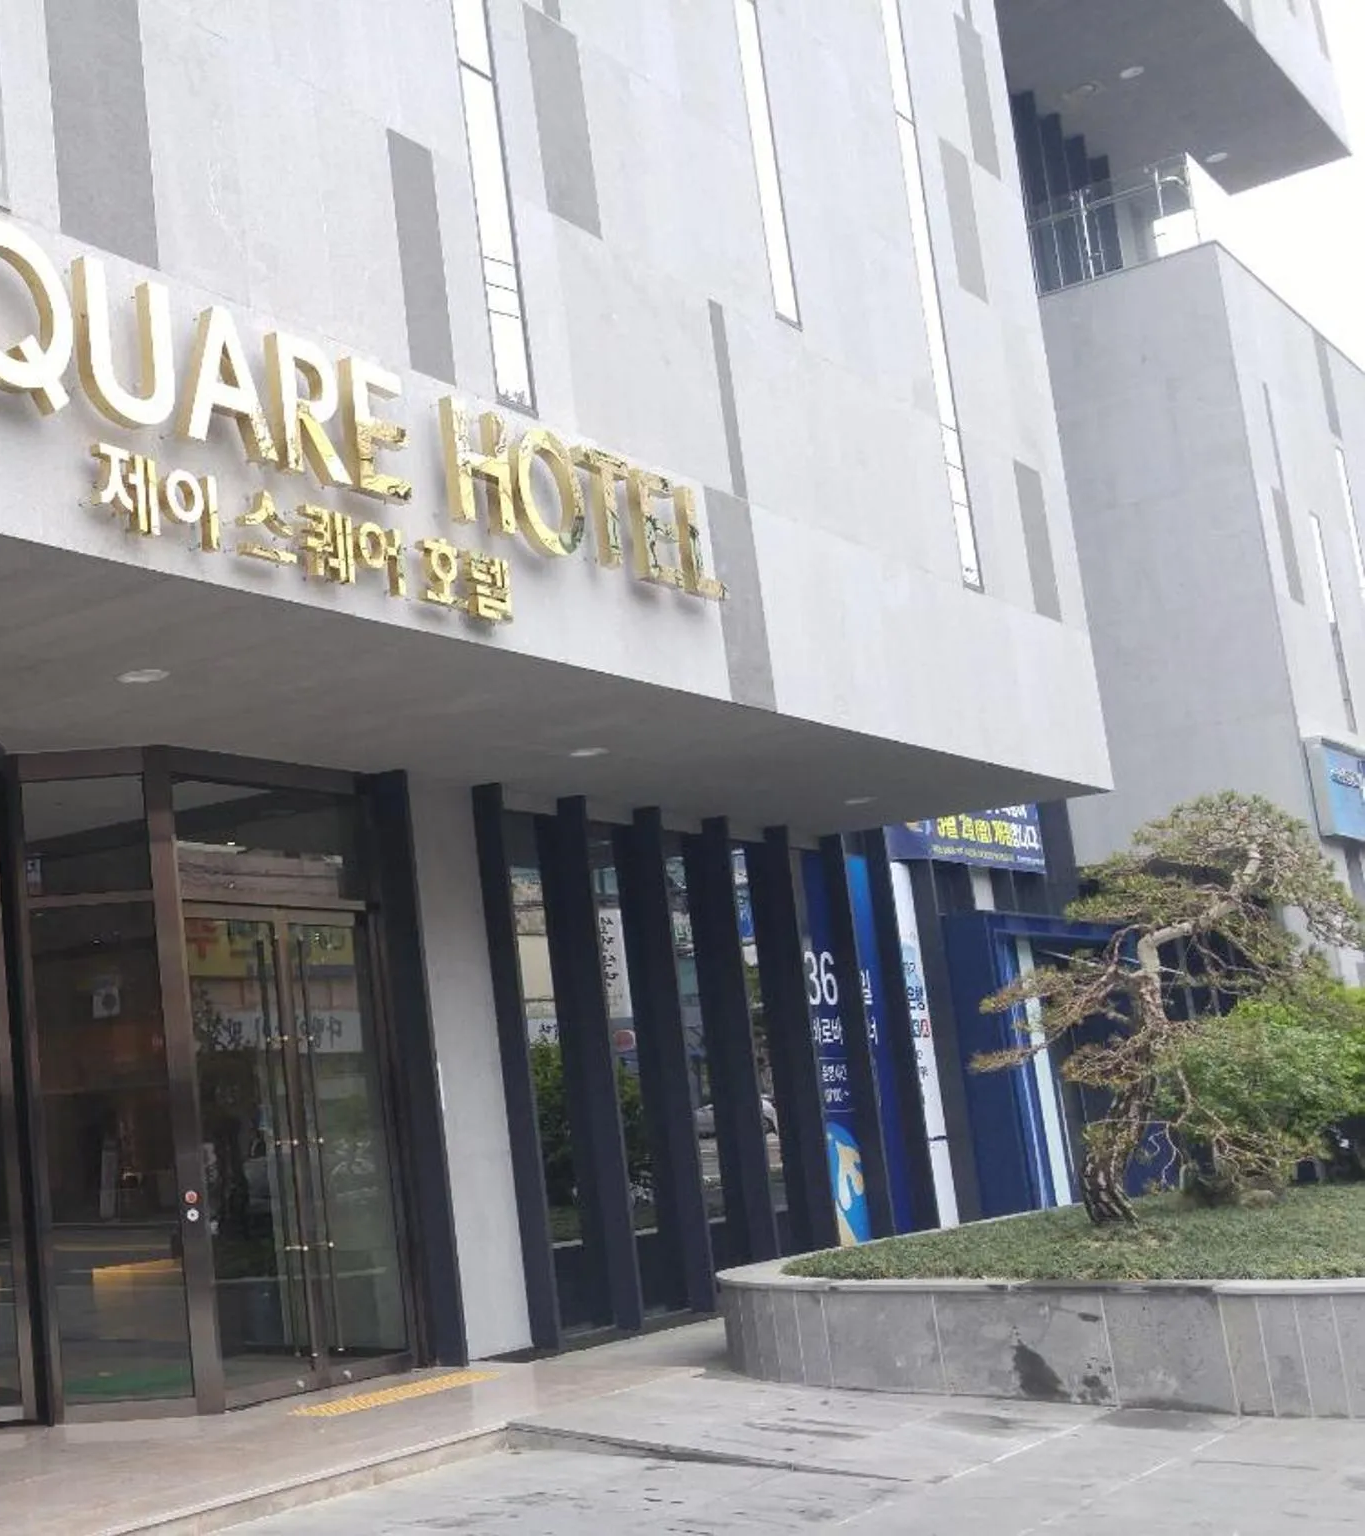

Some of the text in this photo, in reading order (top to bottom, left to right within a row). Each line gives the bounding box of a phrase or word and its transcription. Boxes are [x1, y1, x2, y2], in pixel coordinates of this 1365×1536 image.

[90, 441, 516, 625] 제이 스퀘어 호텔
[438, 394, 730, 602] HOTEL
